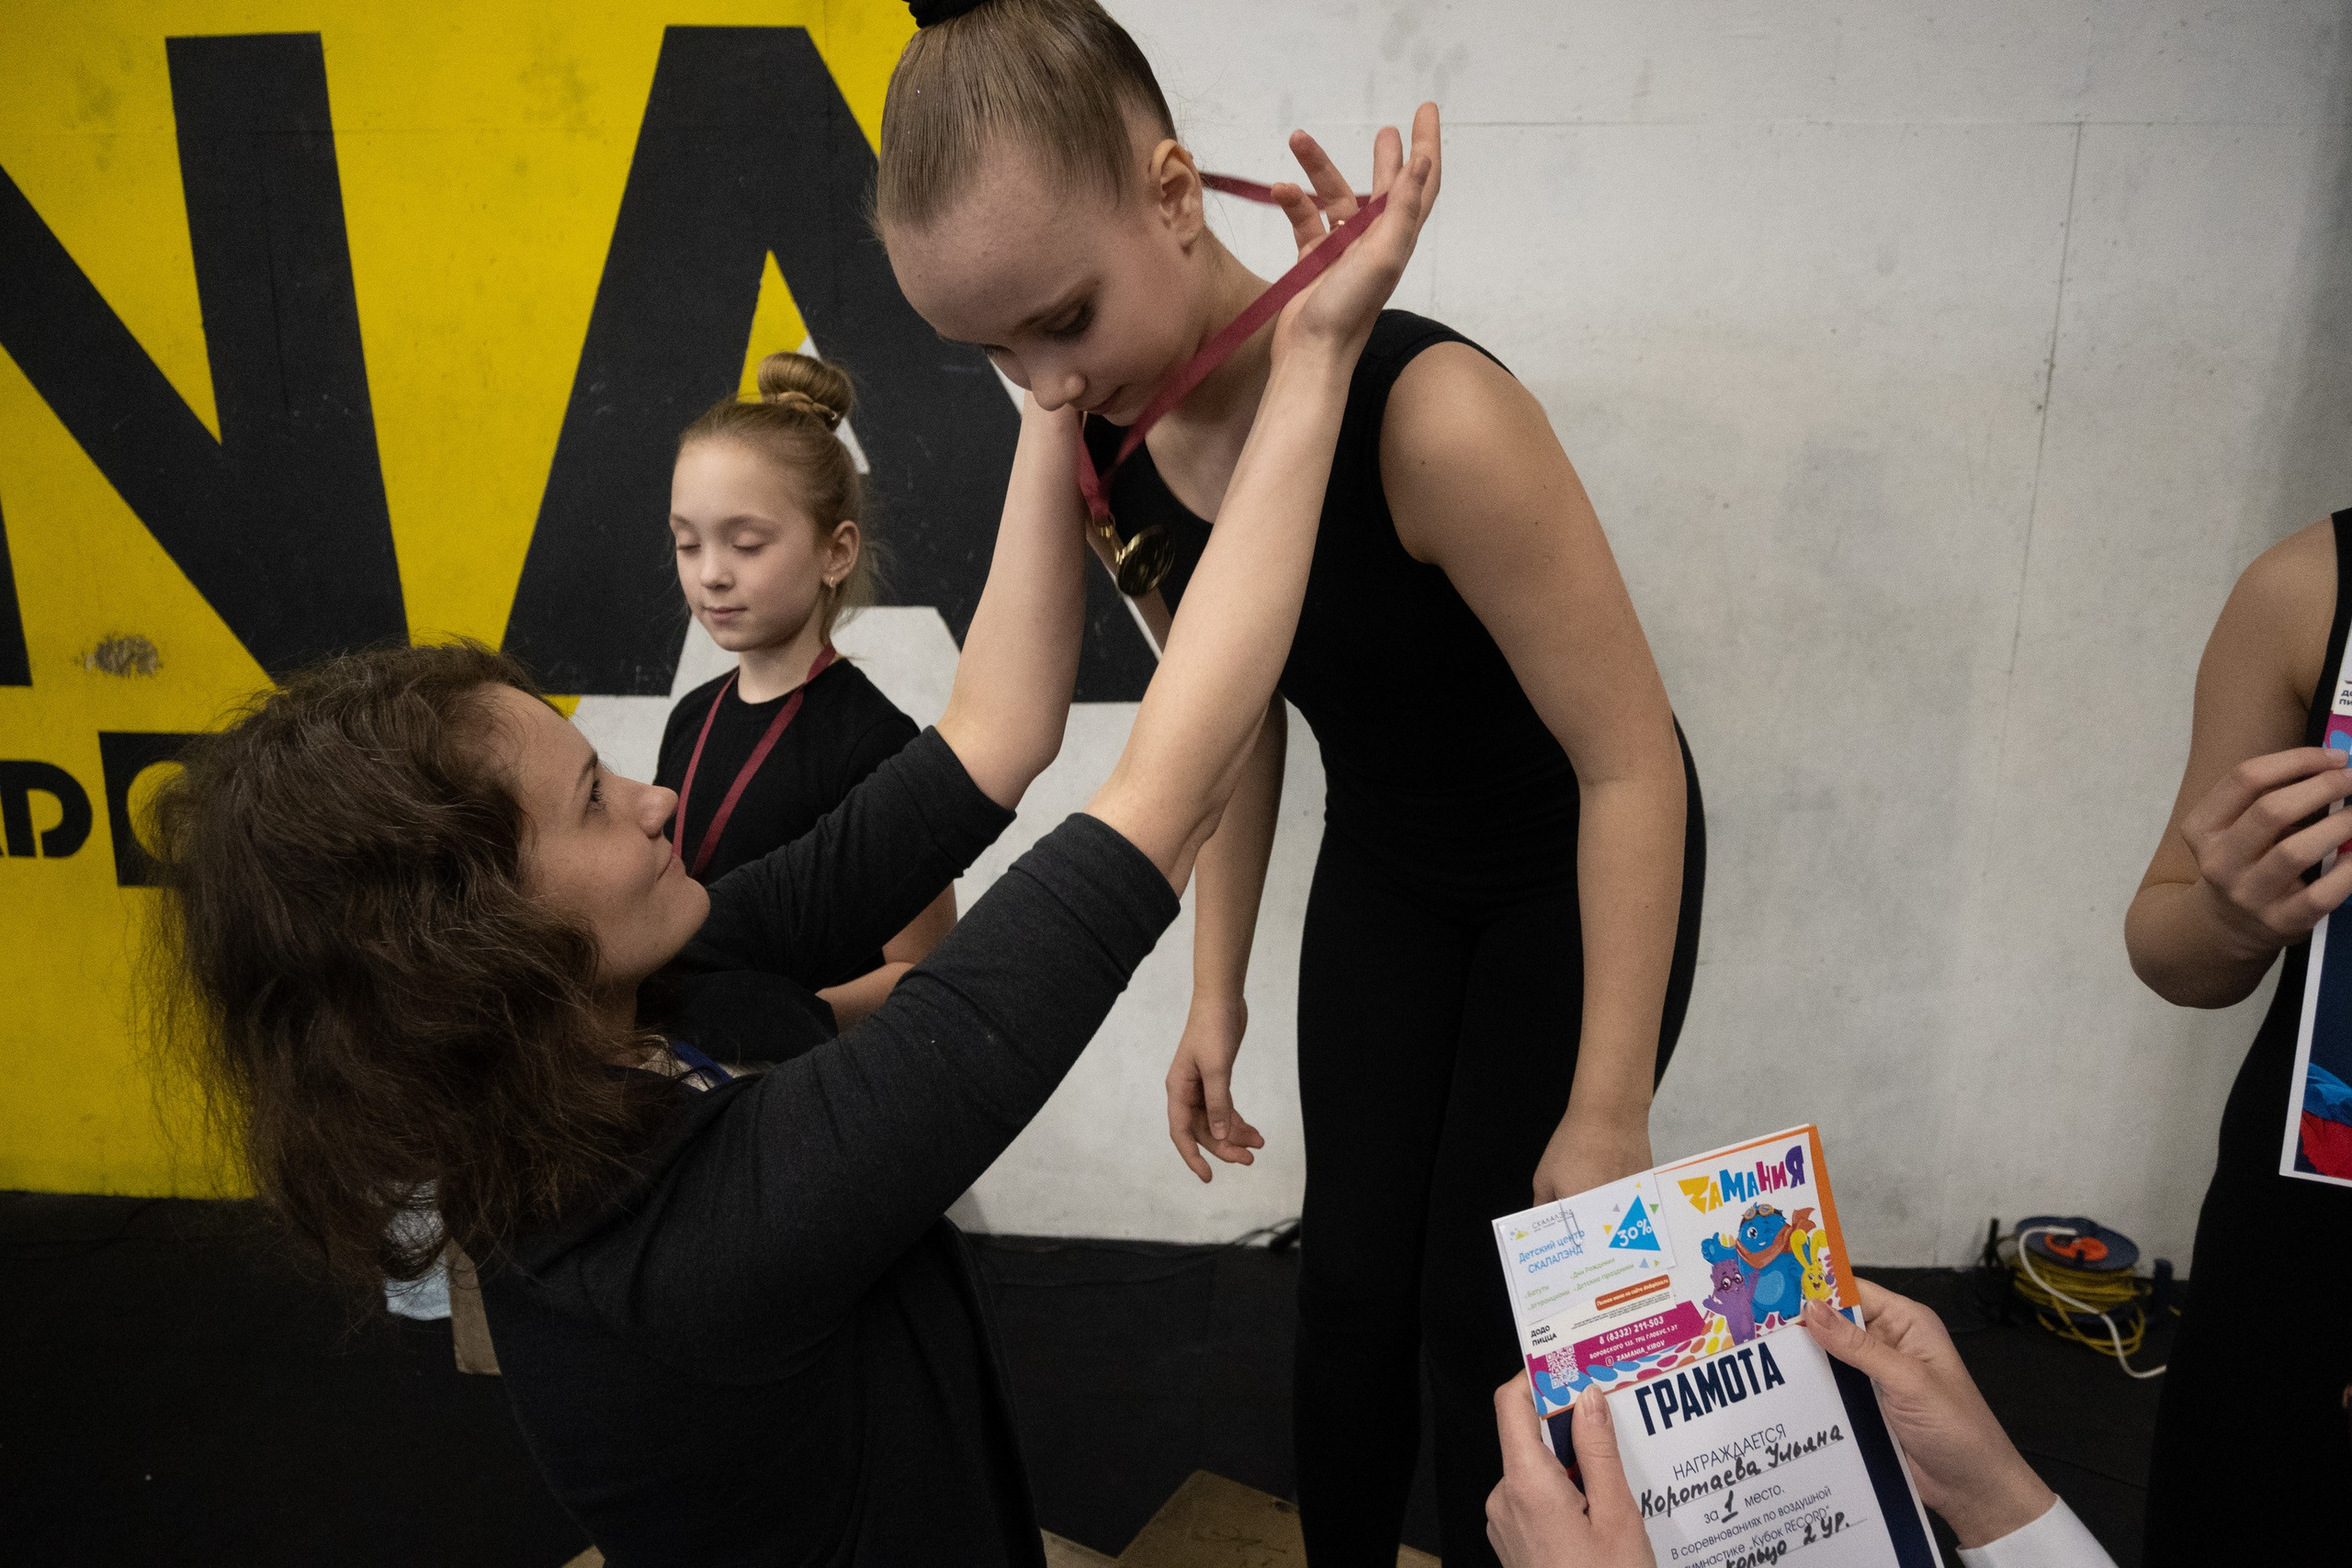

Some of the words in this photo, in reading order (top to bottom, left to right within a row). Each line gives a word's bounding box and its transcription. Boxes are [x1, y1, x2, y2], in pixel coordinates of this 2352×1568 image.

[1616, 1219, 1653, 1247] 30%
[1519, 1241, 1555, 1264] Детский
[1528, 1246, 1584, 1274] СКАЛАЛЭНД
[1531, 1325, 1551, 1338] ДОДО
[1532, 1334, 1557, 1347] ПИЦЦА
[1599, 1336, 1605, 1345] 8
[1606, 1326, 1632, 1342] (8332)
[1634, 1315, 1664, 1333] 211-503
[1616, 1340, 1665, 1361] ZAMANIA_KIROV
[1634, 1342, 1785, 1437] ГРАМОТА
[1673, 1424, 1787, 1481] НАГРАЖДАЕТСЯ
[1640, 1457, 1762, 1518] Коротаева
[1765, 1425, 1844, 1468] Ульяна
[1670, 1548, 1679, 1561] В
[1680, 1517, 1762, 1557] соревнованиях
[1763, 1508, 1777, 1524] по
[1777, 1485, 1832, 1520] воздушной
[1703, 1510, 1719, 1525] за
[1803, 1523, 1816, 1547] 2
[1684, 1543, 1746, 1568] имнастике
